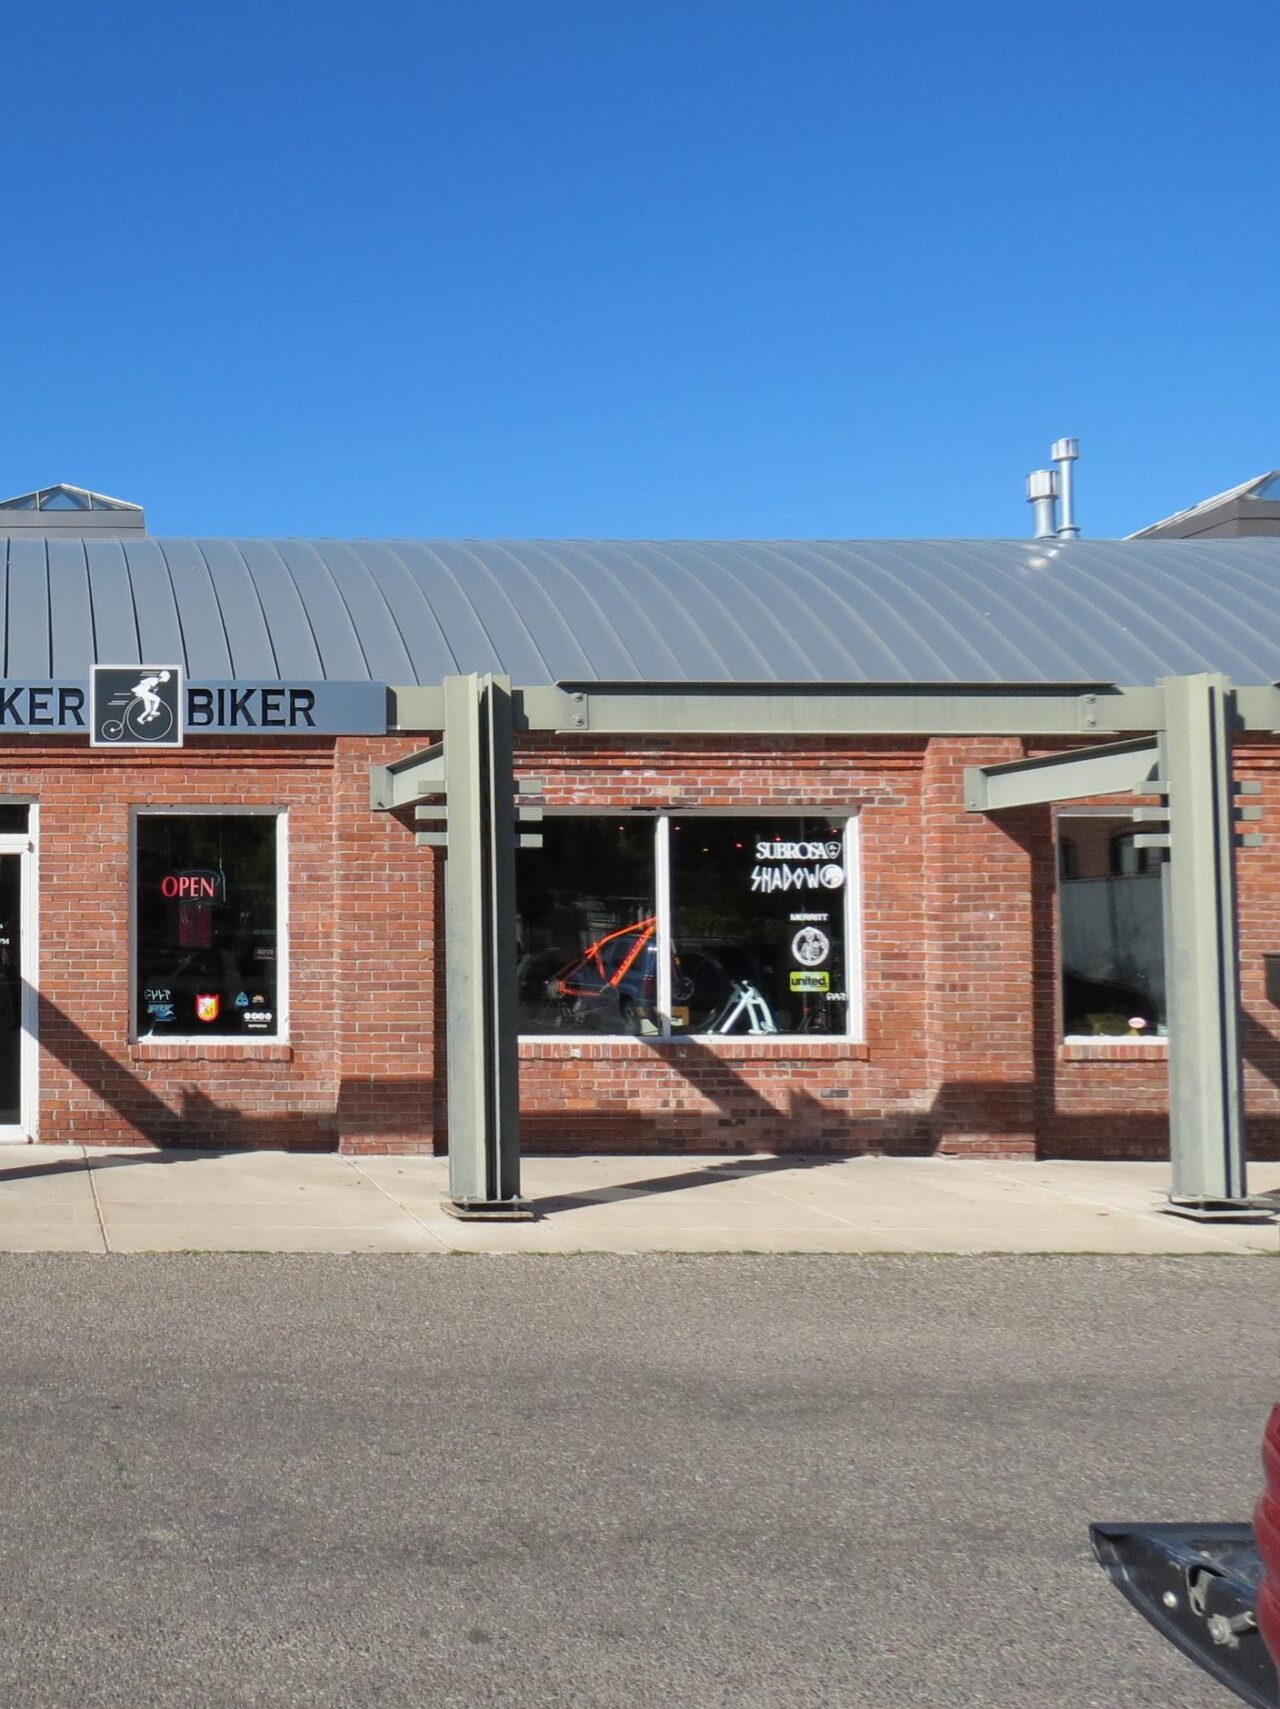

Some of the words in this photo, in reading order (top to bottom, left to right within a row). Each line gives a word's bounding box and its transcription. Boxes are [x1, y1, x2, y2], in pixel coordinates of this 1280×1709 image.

[187, 687, 317, 728] BIKER
[755, 841, 829, 860] SUBROSA
[161, 876, 215, 898] OPEN
[750, 863, 820, 893] SHADOW
[789, 911, 829, 921] MERRITT
